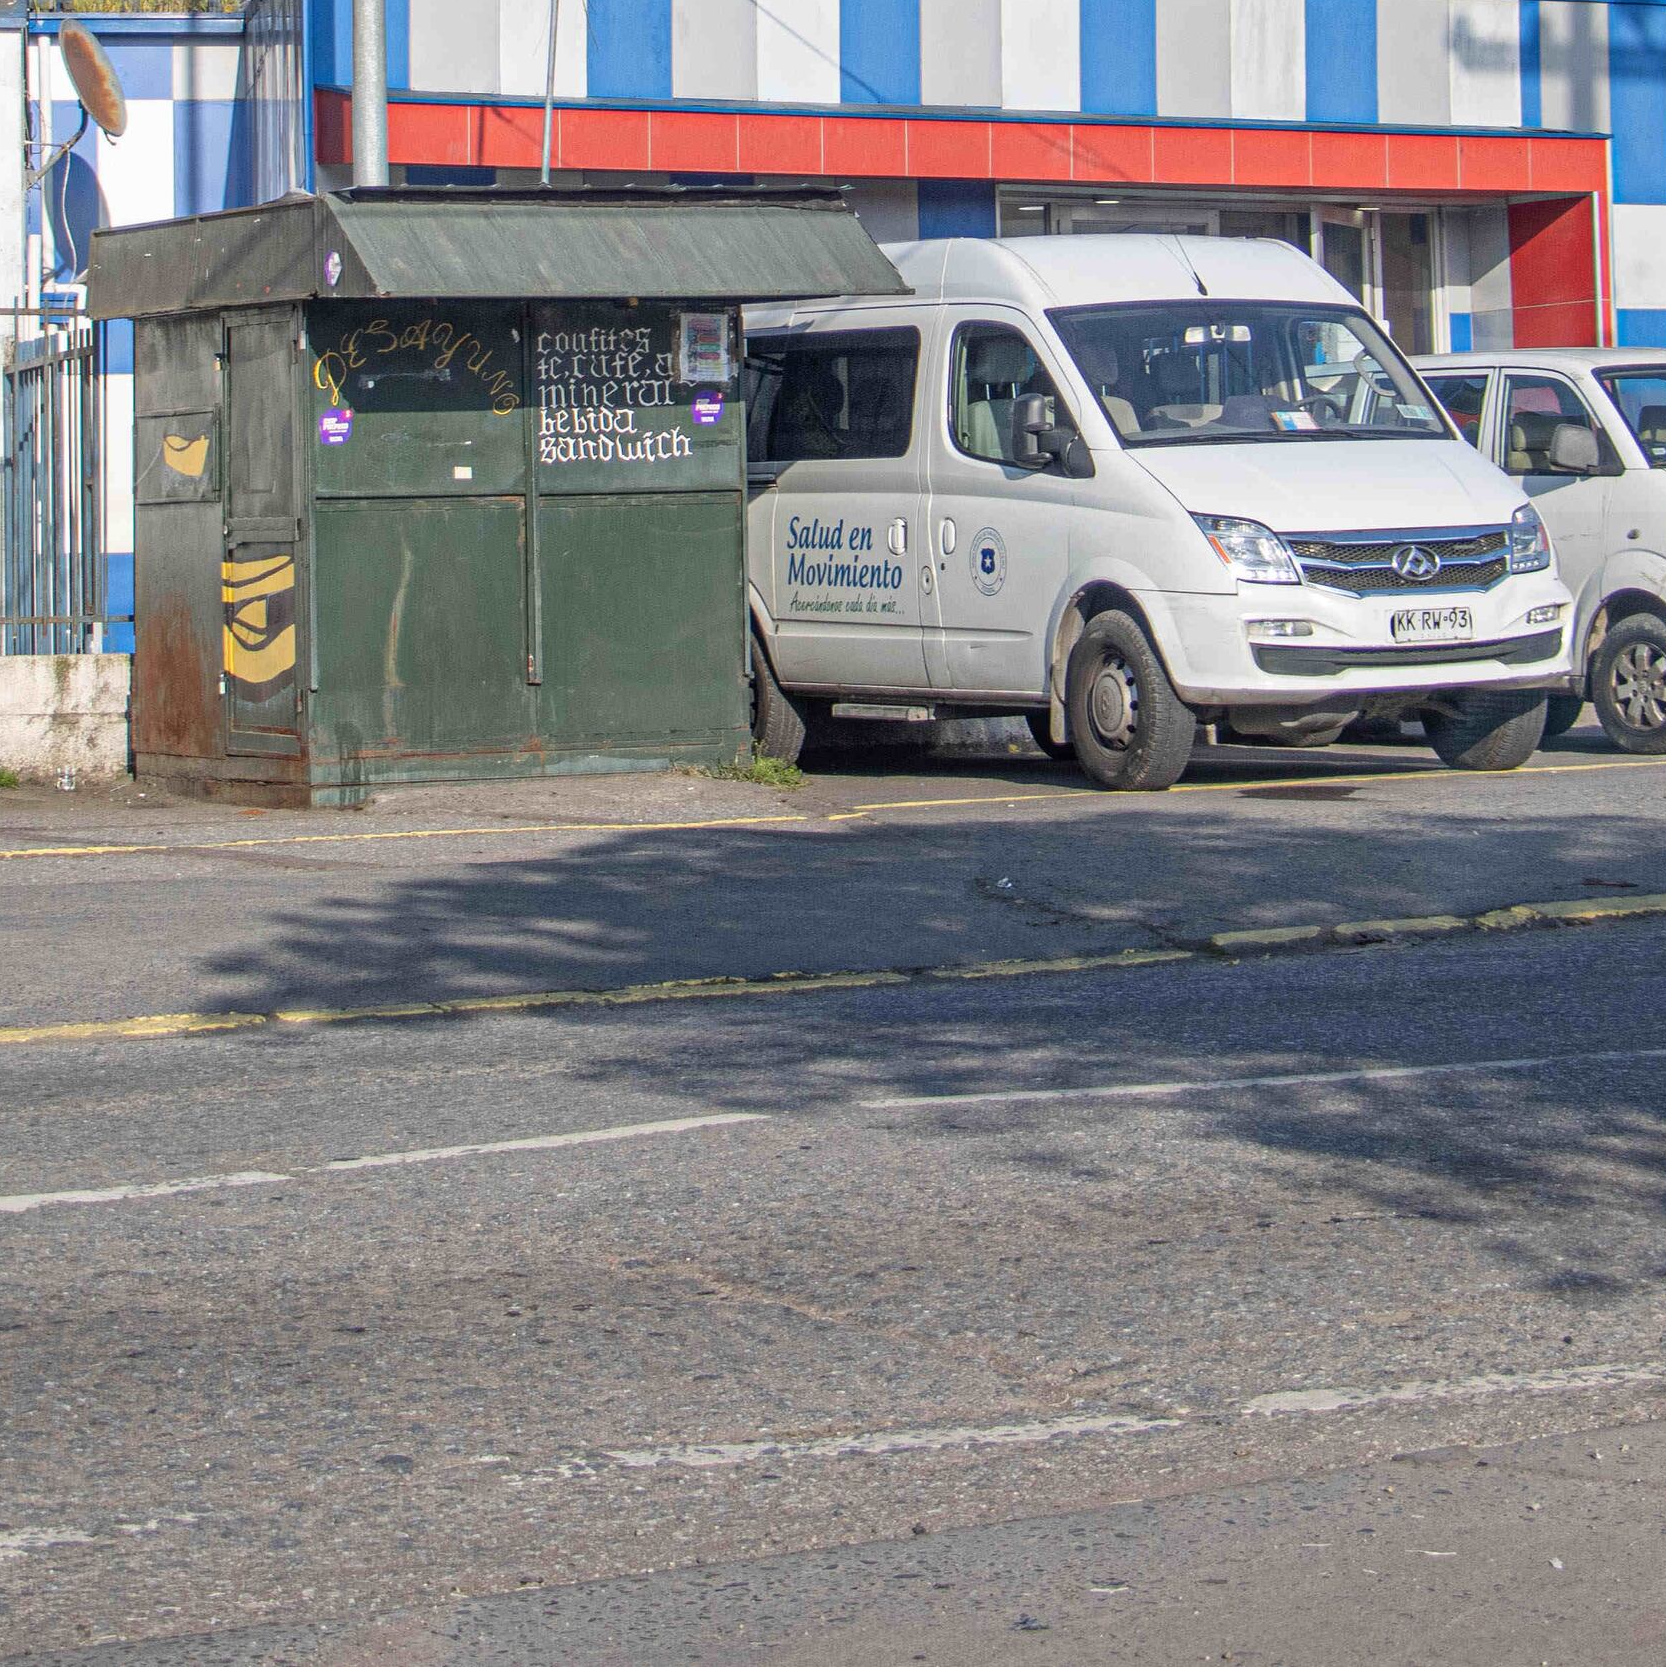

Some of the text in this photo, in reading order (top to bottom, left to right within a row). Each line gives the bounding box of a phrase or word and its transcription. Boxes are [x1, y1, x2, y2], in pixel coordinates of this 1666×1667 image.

[538, 379, 676, 409] mineral
[538, 406, 638, 436] bebida
[540, 426, 694, 464] sandwich
[786, 515, 874, 551] Salud en
[788, 552, 903, 589] Movimiento
